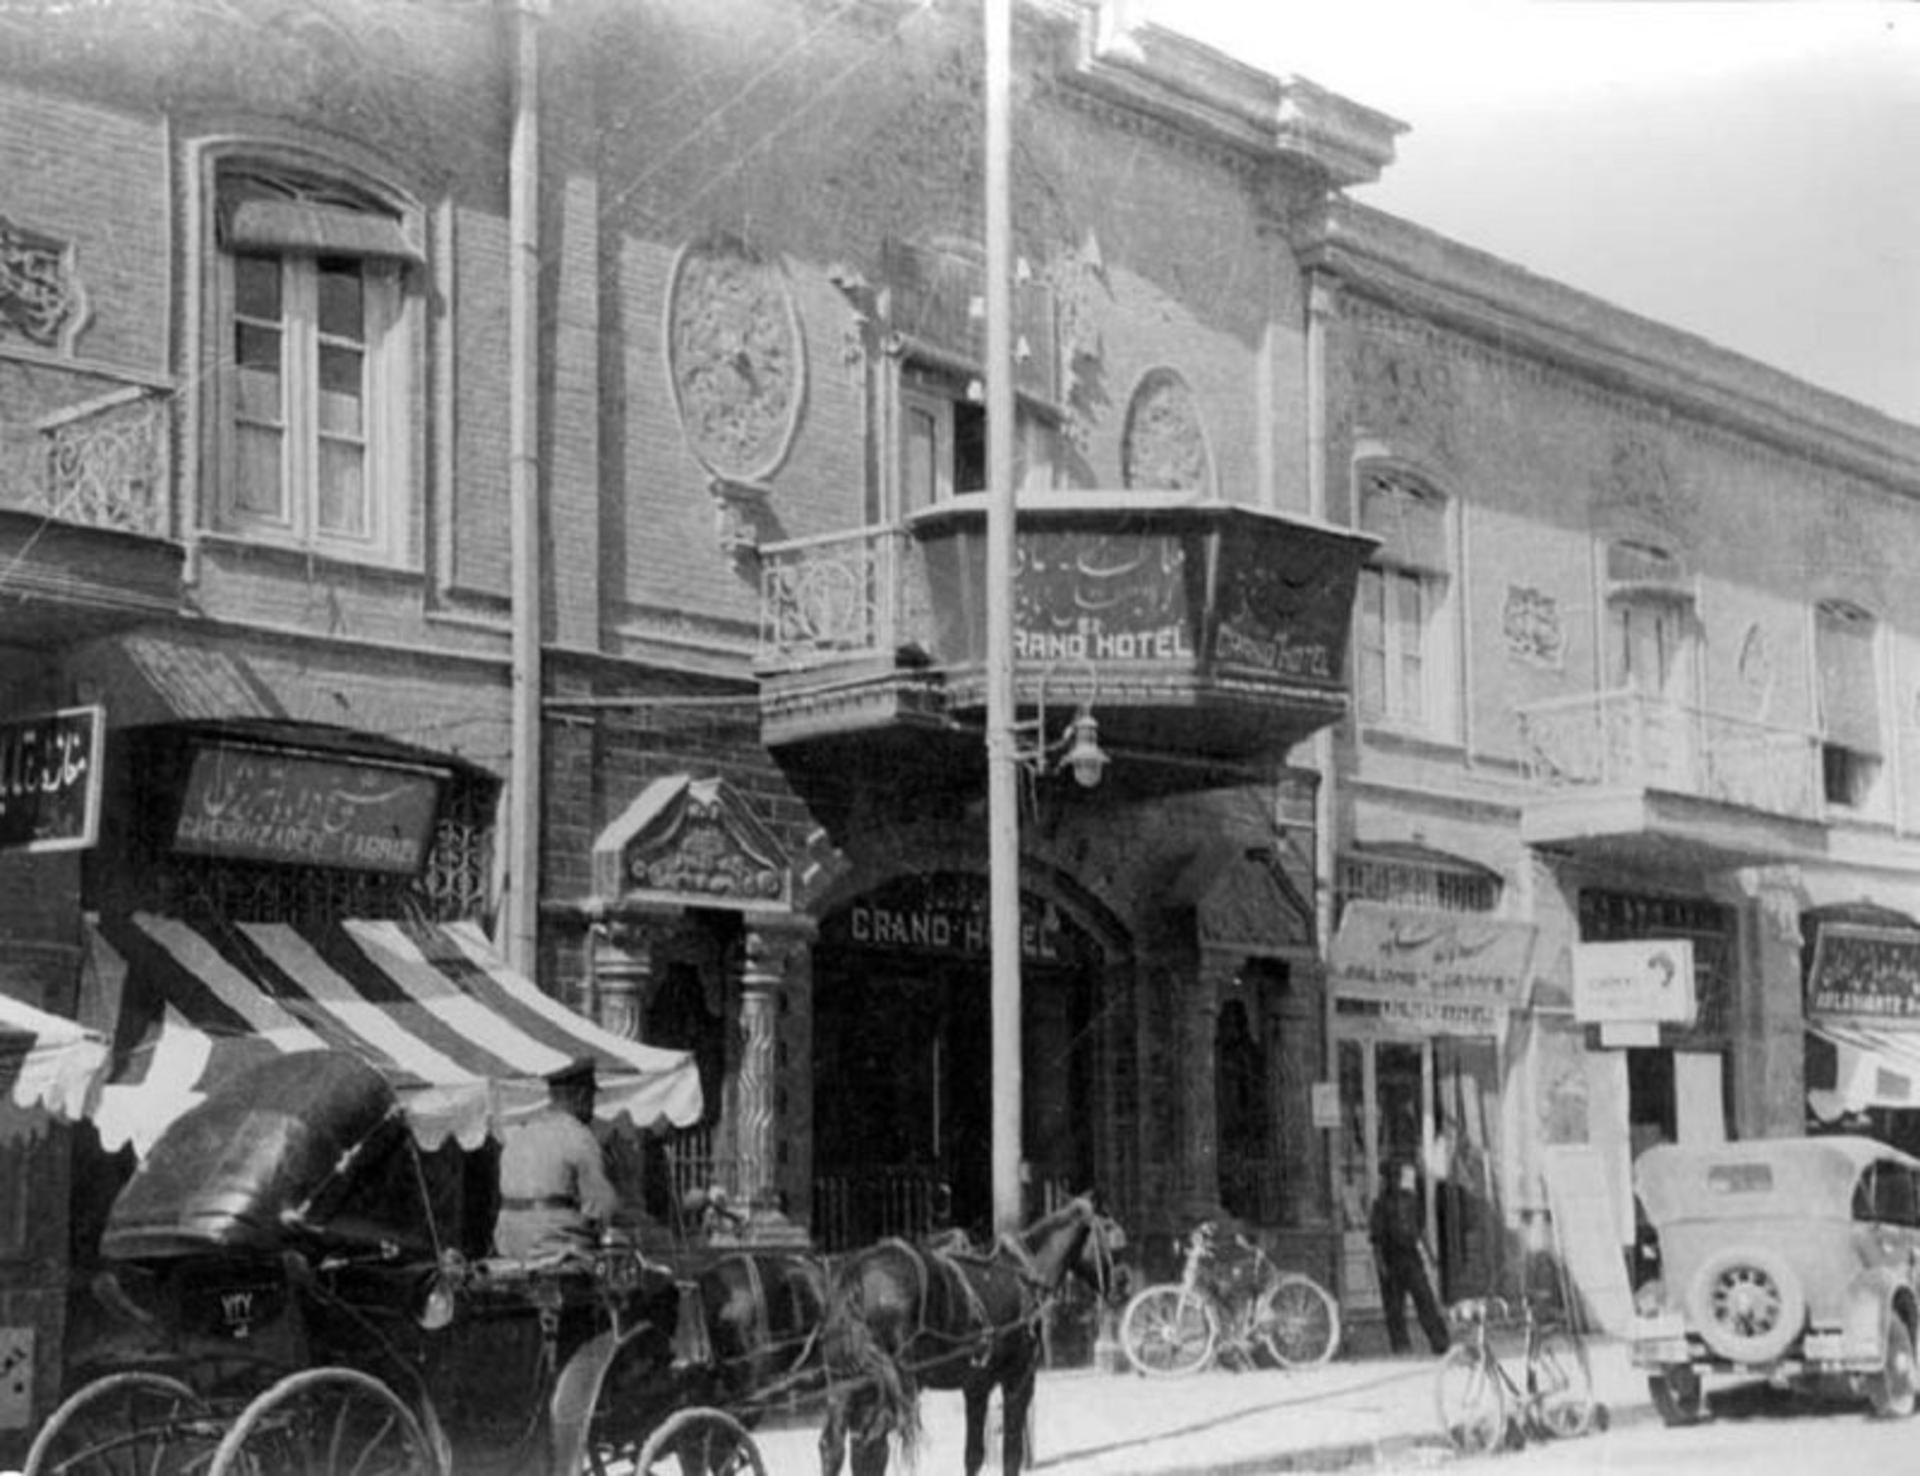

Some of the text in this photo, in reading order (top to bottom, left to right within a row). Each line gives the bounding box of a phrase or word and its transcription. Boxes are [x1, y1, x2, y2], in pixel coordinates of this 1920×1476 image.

[1013, 628, 1088, 659] RAND
[1096, 625, 1193, 658] HOTEL
[850, 906, 1059, 960] GRAND HEL
